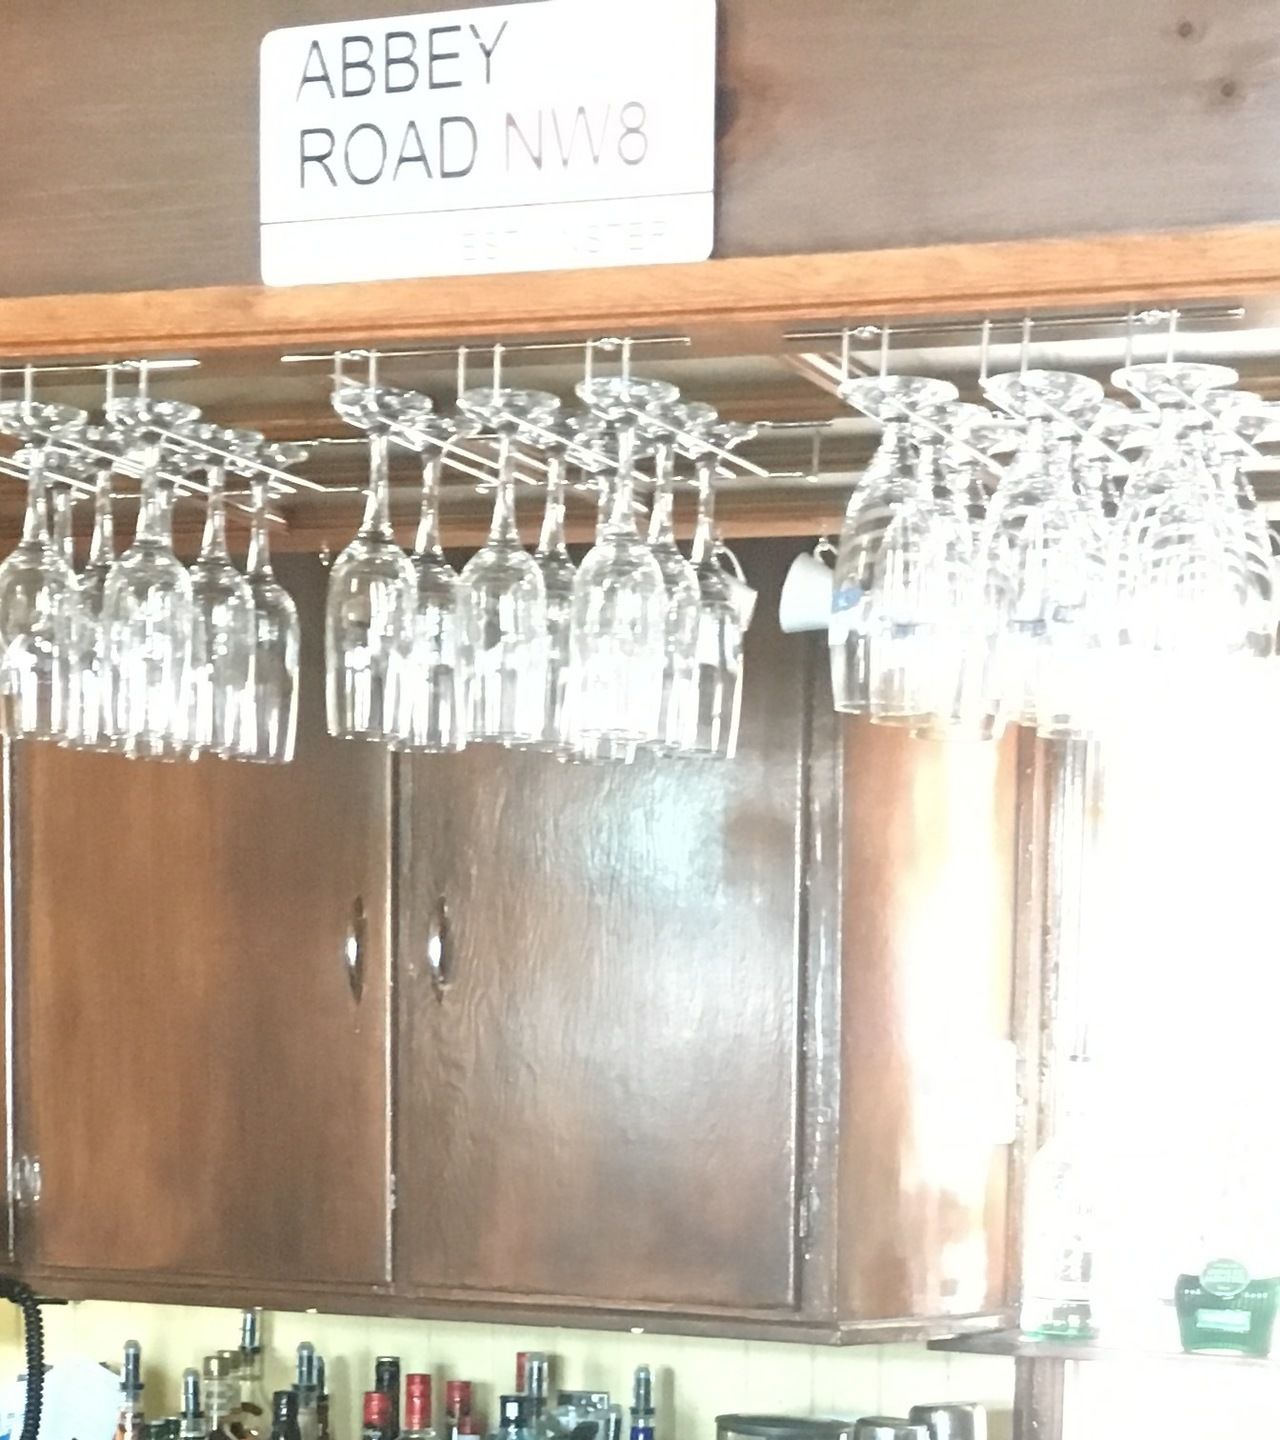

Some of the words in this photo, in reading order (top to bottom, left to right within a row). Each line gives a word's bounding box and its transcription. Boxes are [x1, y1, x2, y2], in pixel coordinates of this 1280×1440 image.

[297, 20, 508, 102] ABBEY
[299, 115, 478, 189] ROAD
[505, 101, 649, 172] NW8
